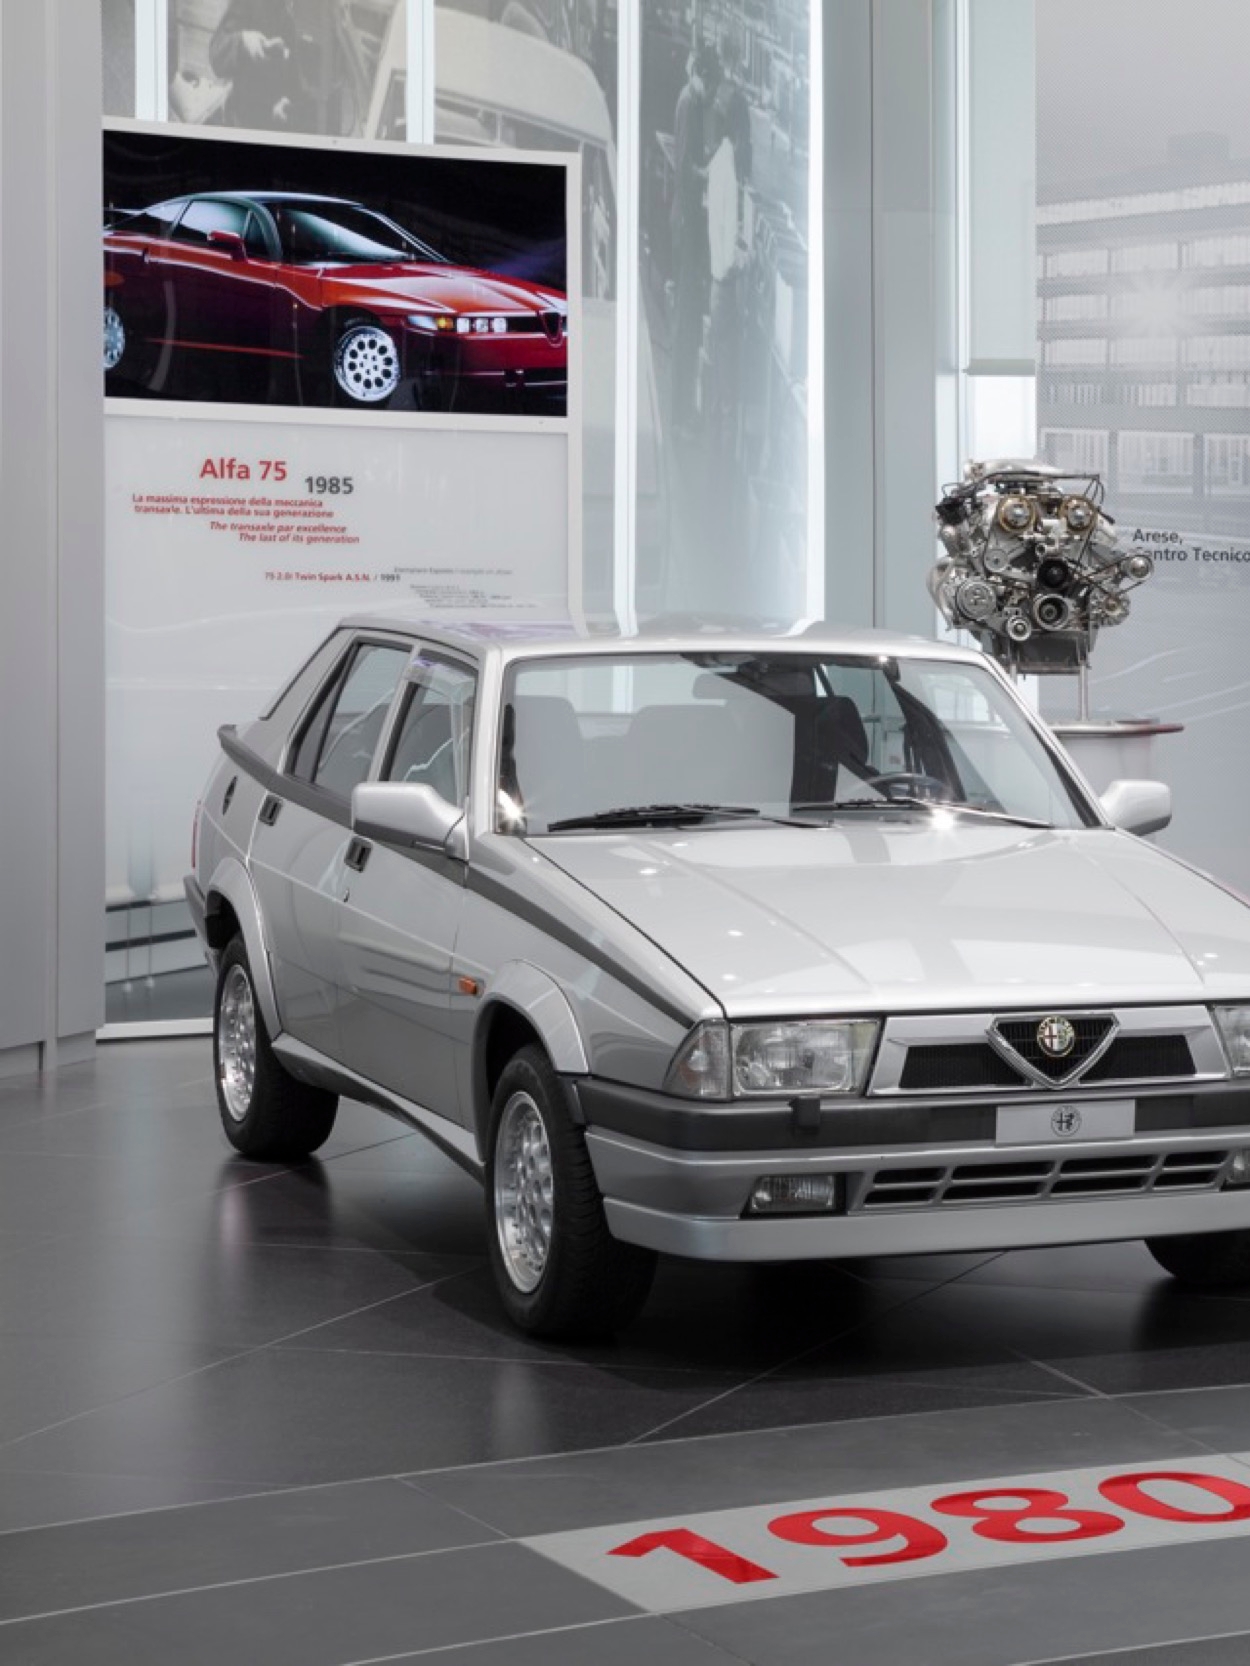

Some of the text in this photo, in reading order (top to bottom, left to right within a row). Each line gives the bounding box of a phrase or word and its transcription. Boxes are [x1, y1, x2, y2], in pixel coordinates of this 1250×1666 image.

[199, 458, 288, 482] Alfa 75
[304, 476, 354, 495] 1985
[132, 493, 323, 508] La massima espressione della meccanica
[228, 507, 251, 517] della
[254, 508, 270, 517] sua
[273, 509, 334, 519] generazione
[210, 521, 347, 535] The transaxle par excellence
[239, 533, 360, 546] The last of its generation
[1132, 528, 1183, 546] Arese,
[1135, 547, 1188, 562] ntro
[294, 572, 317, 581] Twin
[317, 572, 343, 583] Spark
